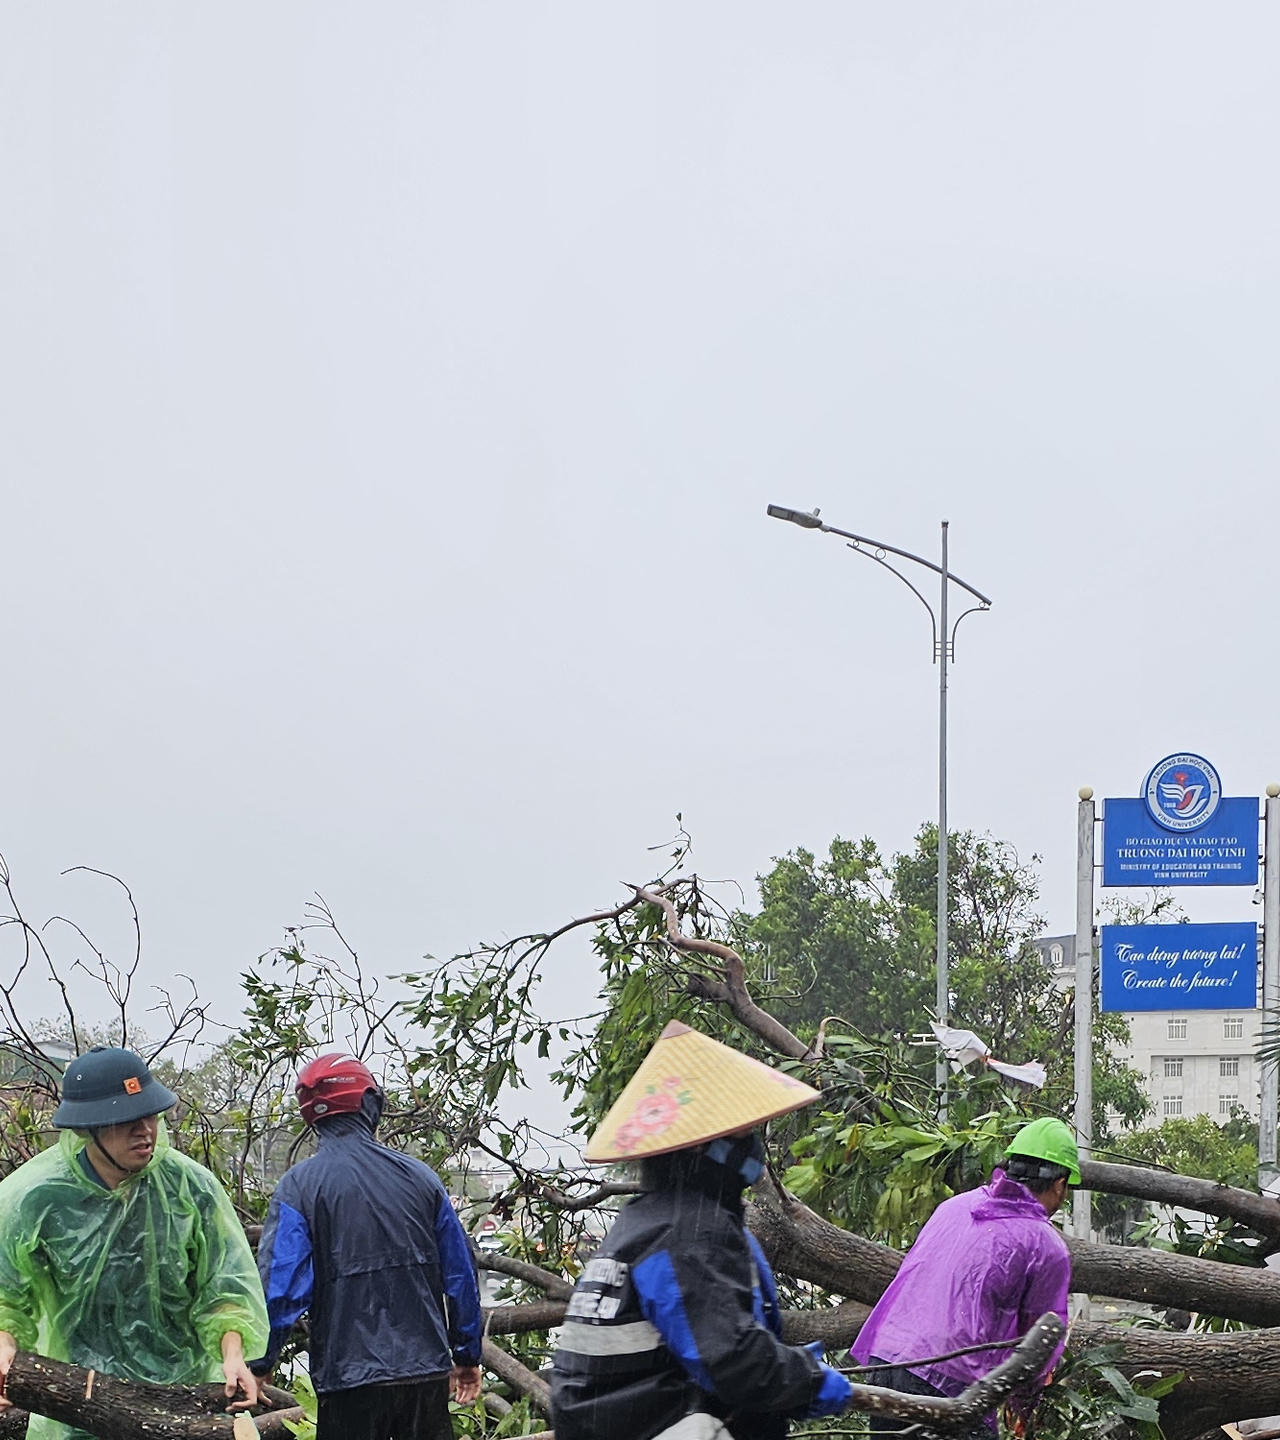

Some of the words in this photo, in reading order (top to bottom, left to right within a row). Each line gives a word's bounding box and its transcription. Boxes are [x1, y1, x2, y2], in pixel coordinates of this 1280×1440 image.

[1217, 847, 1246, 858] VINH
[1220, 943, 1246, 960] lai!
[1121, 969, 1167, 990] Create
[1170, 972, 1189, 988] the
[1184, 970, 1238, 994] future!
